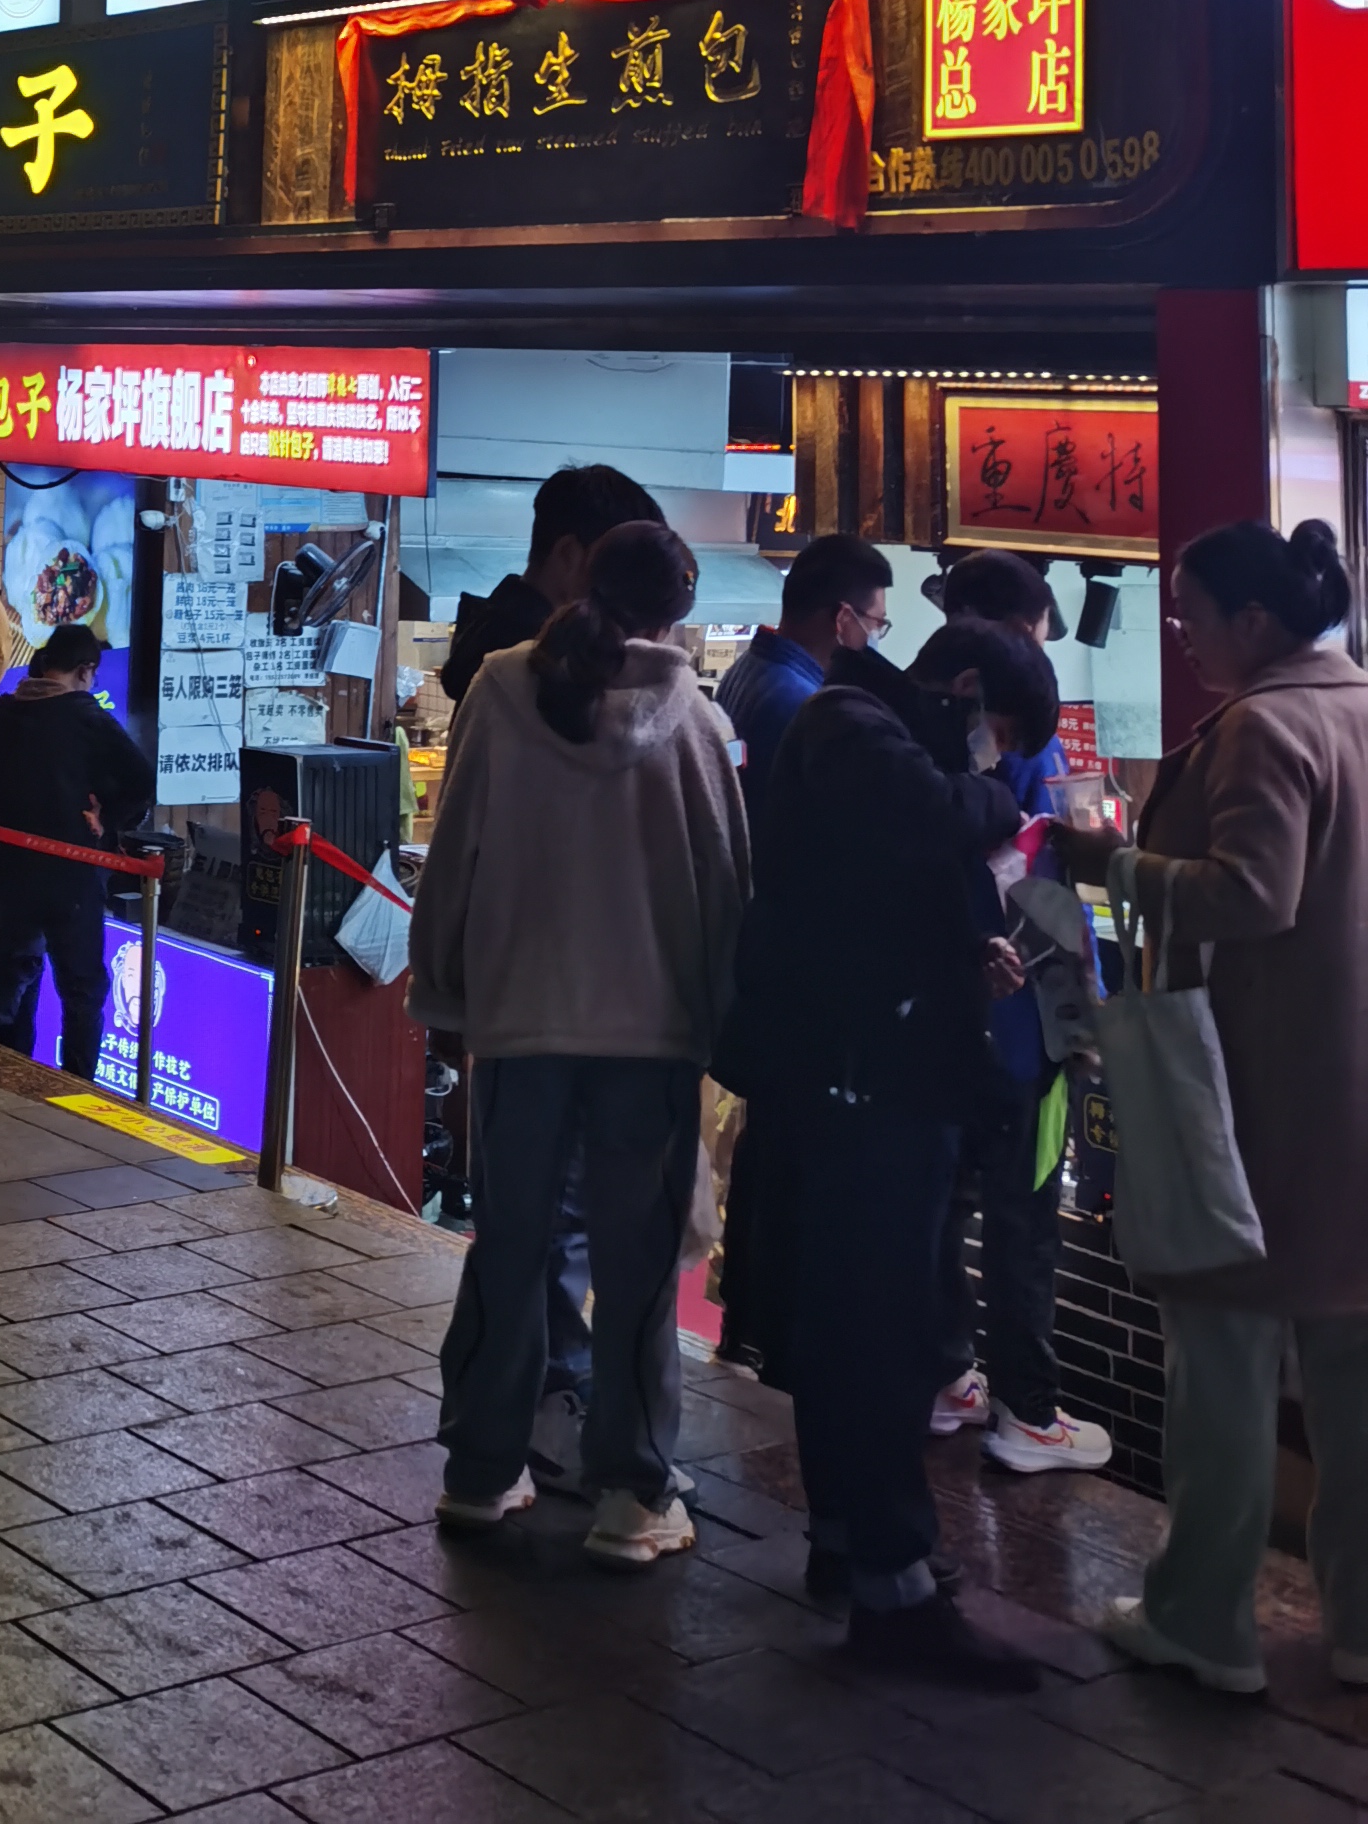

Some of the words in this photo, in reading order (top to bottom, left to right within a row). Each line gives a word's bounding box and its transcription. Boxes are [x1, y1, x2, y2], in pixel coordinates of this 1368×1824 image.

[384, 10, 762, 124] 拇指生煎包
[56, 365, 234, 454] 杨家坪旗舰店
[162, 674, 242, 702] 每人限购三笼
[159, 752, 240, 774] 请依次排队
